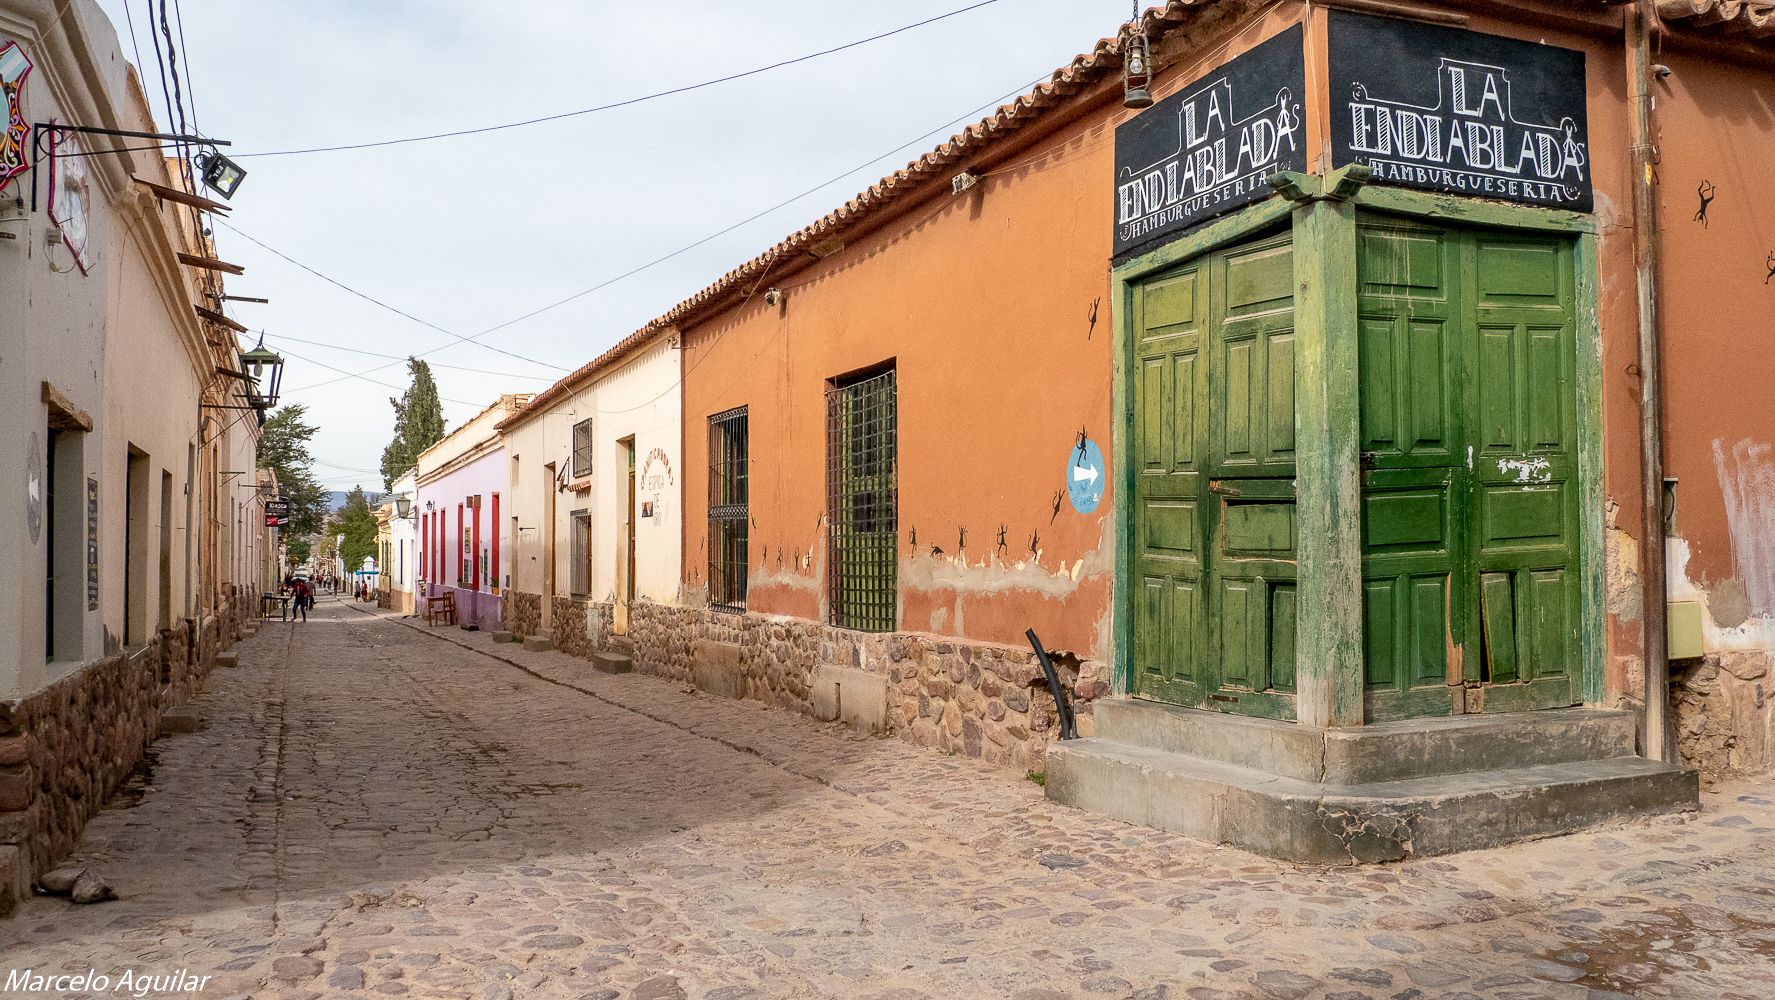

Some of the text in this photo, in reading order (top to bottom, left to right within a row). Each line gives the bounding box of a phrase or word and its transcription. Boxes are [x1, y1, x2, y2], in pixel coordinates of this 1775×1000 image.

[1184, 90, 1225, 149] LA
[1448, 66, 1505, 122] LA
[1118, 106, 1297, 224] ENDIABLADA
[1349, 102, 1584, 182] ENDIABLADA
[1131, 170, 1268, 239] HAMBURGUESERIA
[1371, 161, 1562, 202] HAMBURGUESERIA
